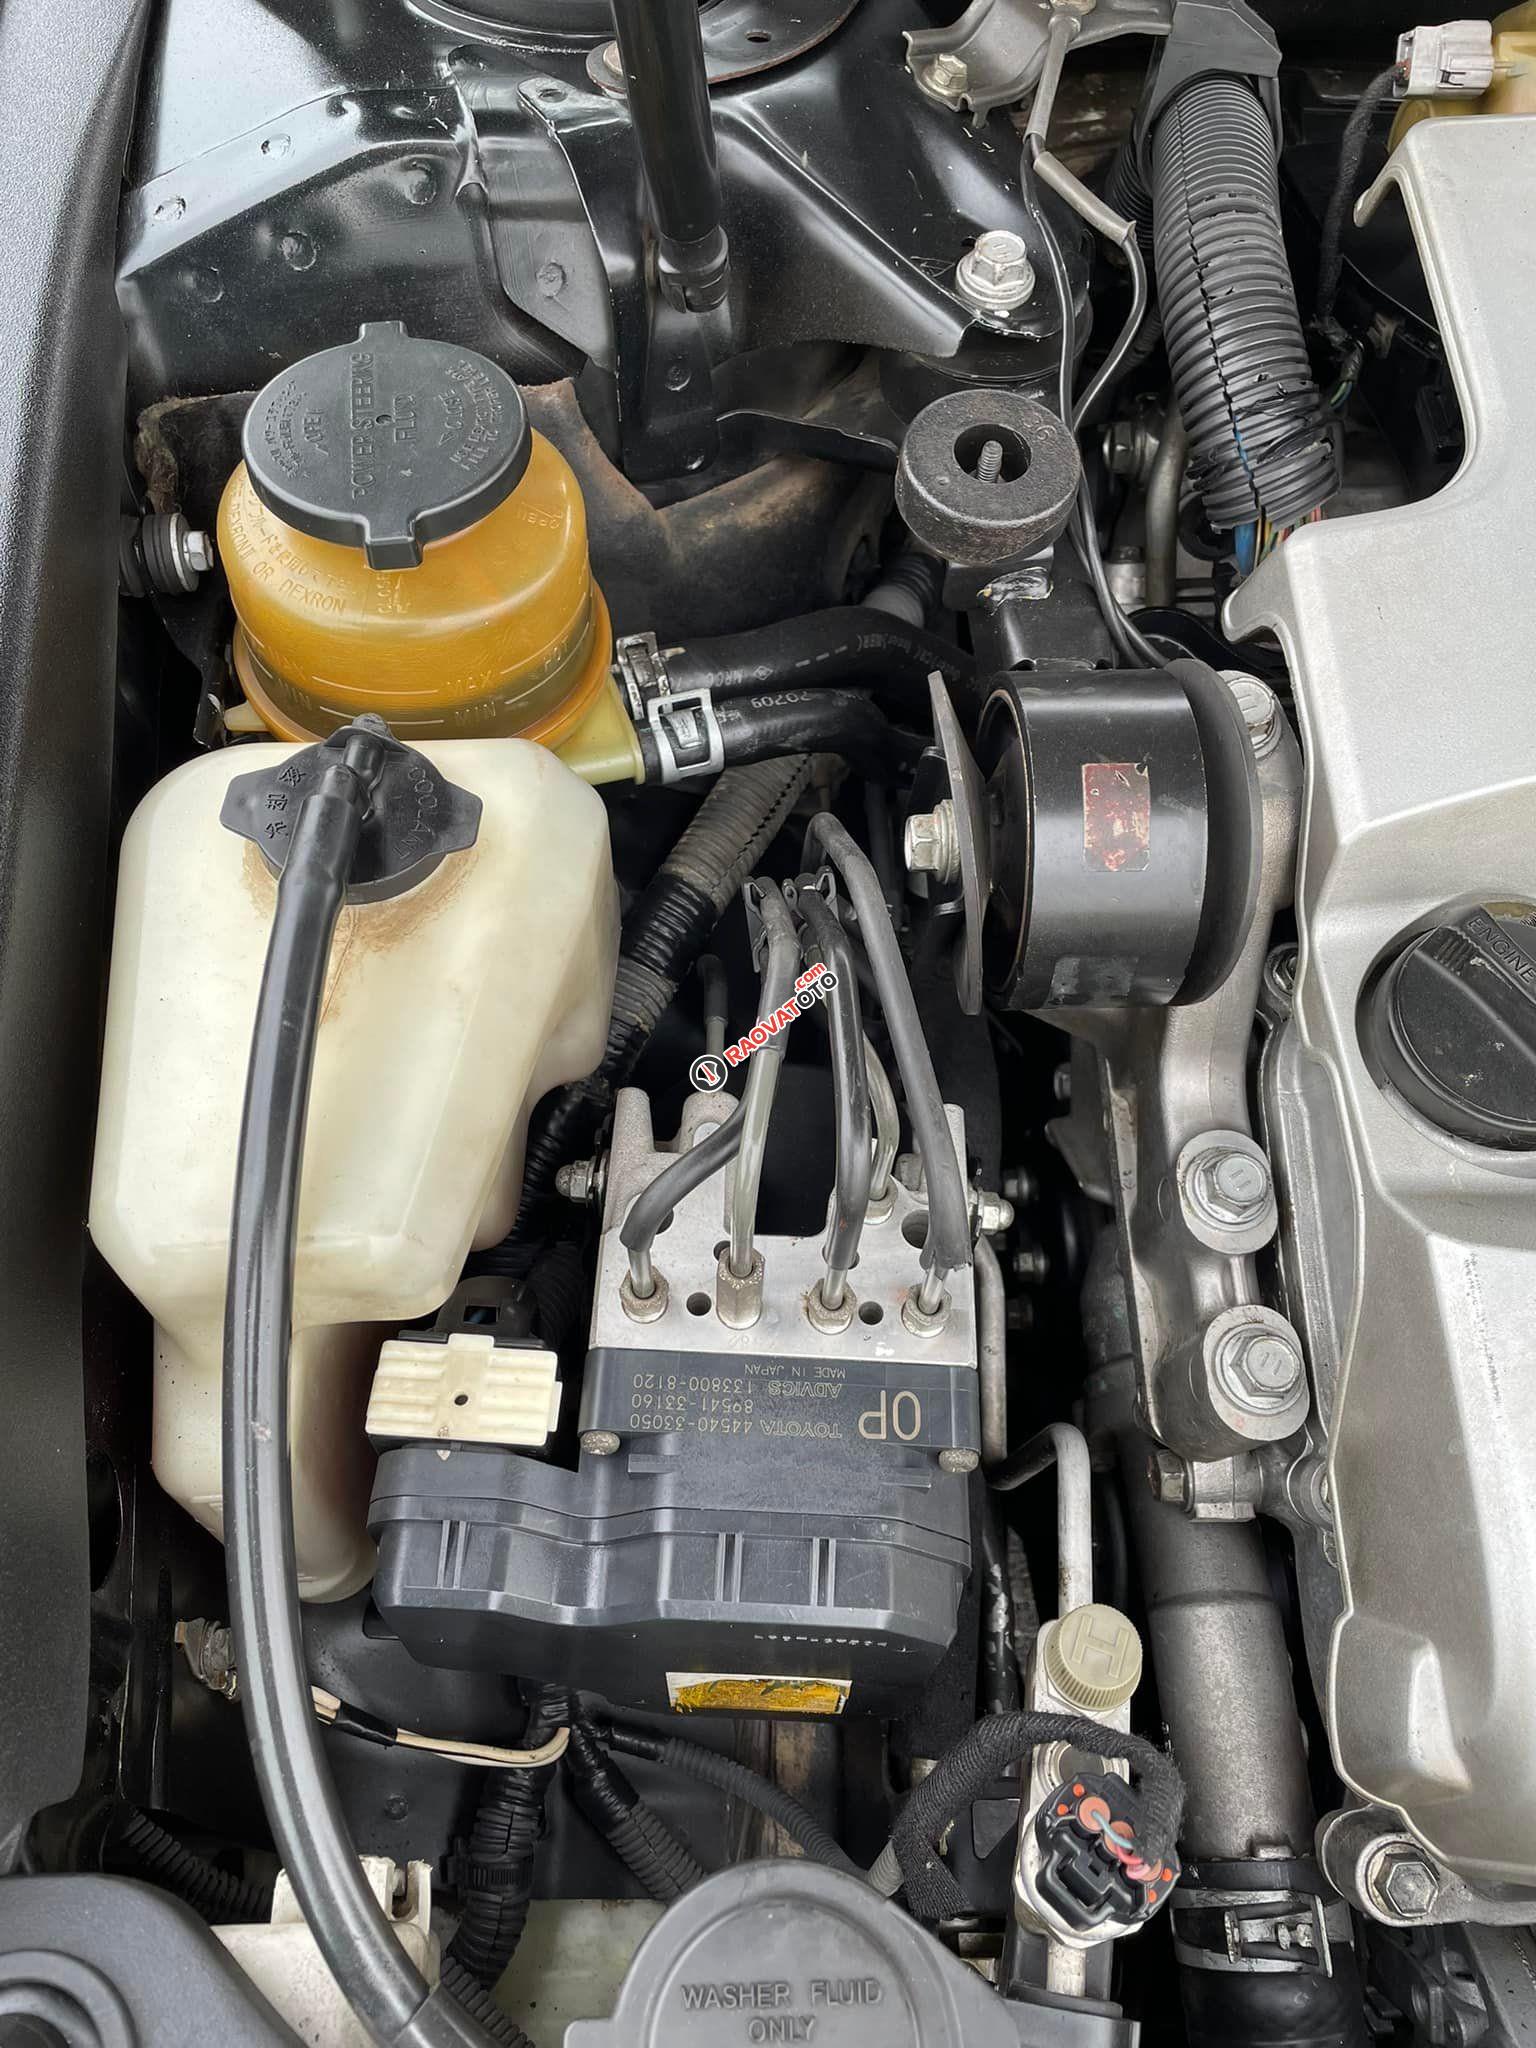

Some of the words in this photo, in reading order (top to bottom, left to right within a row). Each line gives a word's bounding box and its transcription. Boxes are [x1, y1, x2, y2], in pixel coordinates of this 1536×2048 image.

[350, 352, 376, 430] STEERING
[350, 435, 376, 500] POWER
[278, 577, 347, 617] DEXRON
[392, 764, 438, 861] COOLANT
[1467, 916, 1536, 984] ENGINE
[744, 1363, 785, 1378] JAPAN
[791, 1365, 806, 1378] IN
[813, 1365, 847, 1379] MADE
[632, 1373, 753, 1394] 133800-8120
[767, 1379, 843, 1399] ADVICS
[631, 1393, 754, 1414] 89541-33160
[630, 1413, 753, 1434] 44540-33050
[760, 1418, 843, 1440] TOYOTA
[1070, 1612, 1130, 1679] H
[681, 1981, 792, 2010] WASHER
[808, 1977, 884, 2005] FLUID
[747, 2014, 817, 2043] ONLY
